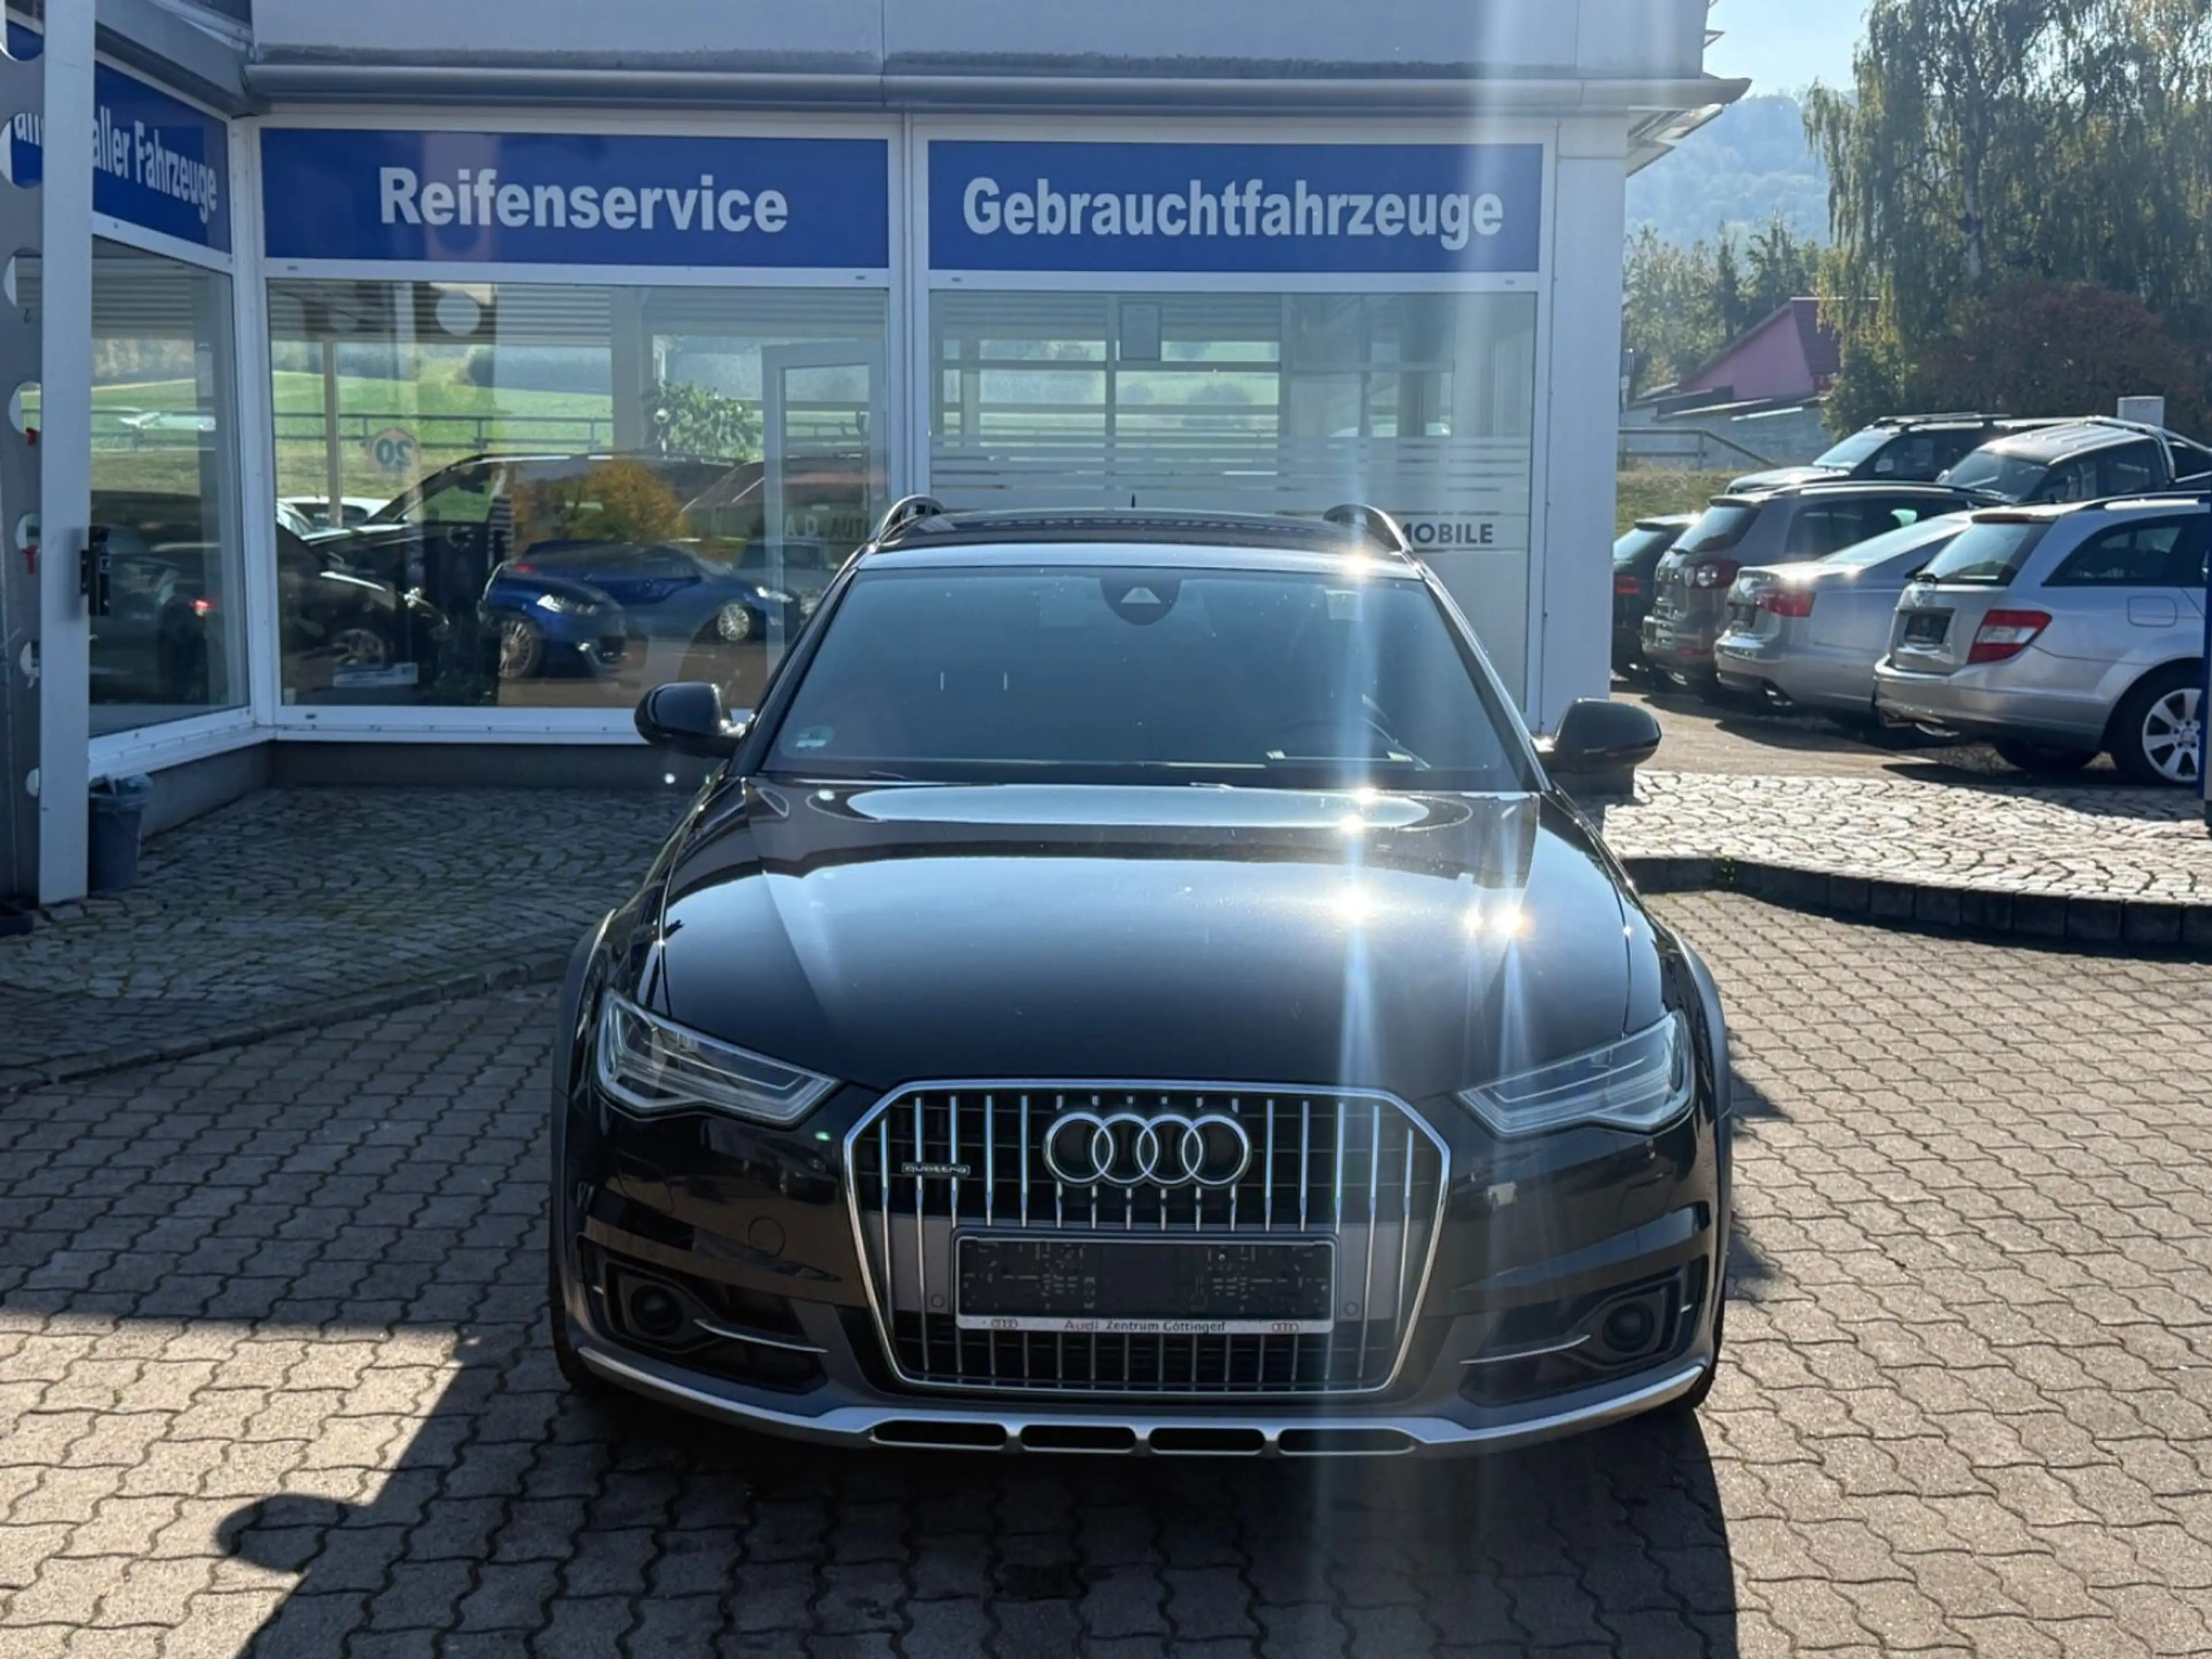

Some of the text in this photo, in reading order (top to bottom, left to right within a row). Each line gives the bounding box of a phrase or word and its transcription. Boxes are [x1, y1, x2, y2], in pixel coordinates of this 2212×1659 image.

[134, 120, 217, 224] Fahrzeuge
[380, 167, 787, 232] Reifenservice
[963, 177, 1504, 251] Gebrauchtfahrzeuge
[905, 1165, 967, 1173] quattro
[1064, 1319, 1099, 1330] Audi
[1105, 1320, 1158, 1331] Zentrum
